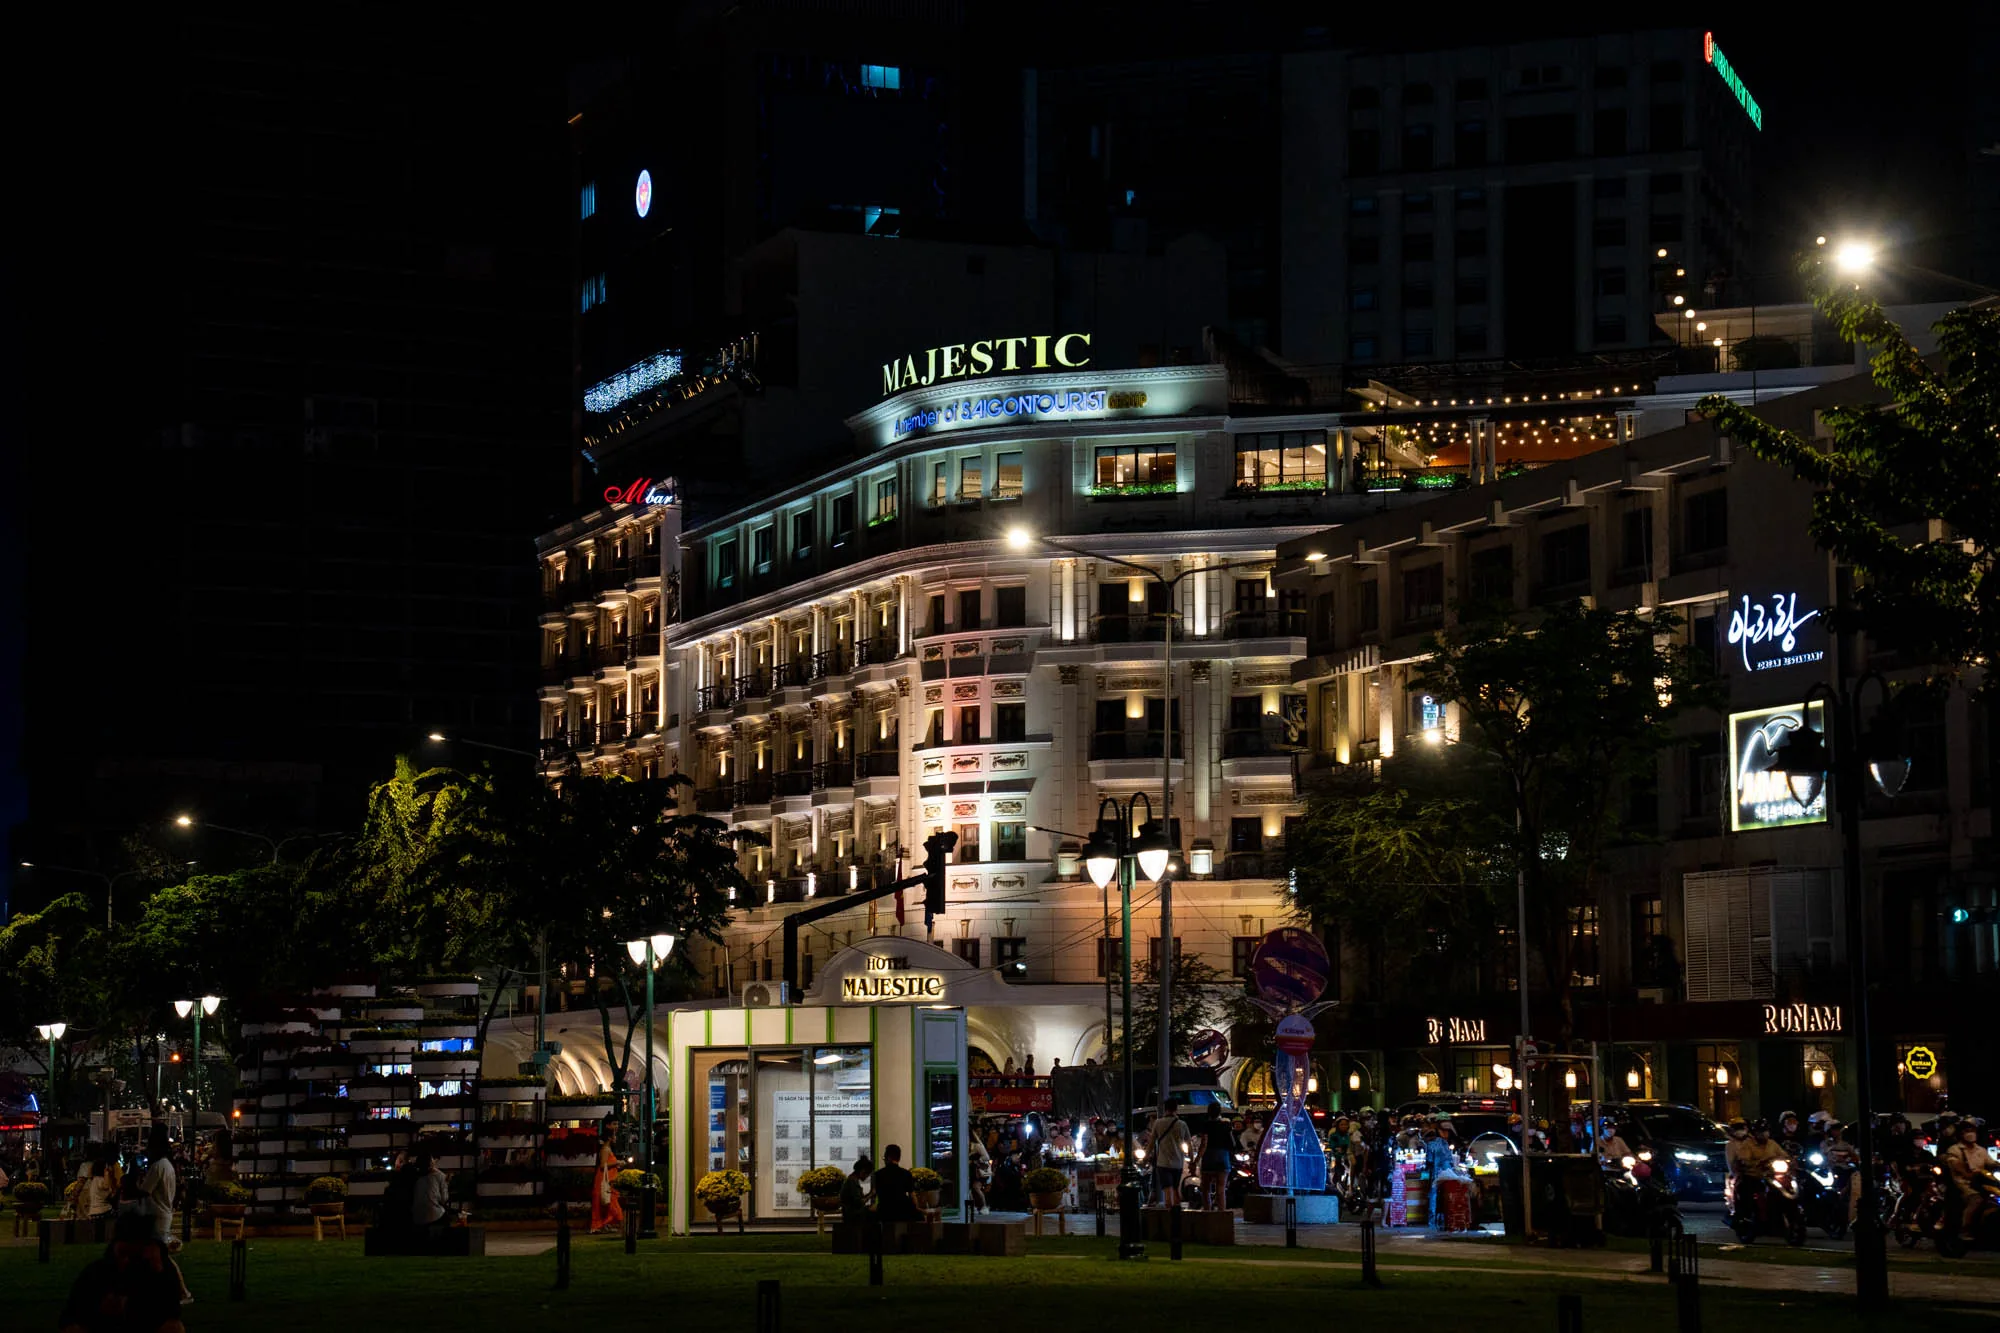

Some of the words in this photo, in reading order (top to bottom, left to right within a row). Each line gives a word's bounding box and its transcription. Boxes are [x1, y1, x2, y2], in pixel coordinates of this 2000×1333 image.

[882, 333, 1092, 396] MAJESTIC
[893, 417, 901, 438] A
[900, 408, 941, 433] member
[943, 401, 958, 423] of
[960, 390, 1107, 421] SAIGONTOURIST
[867, 955, 912, 971] HOTEL
[843, 977, 941, 996] MAJESTIC
